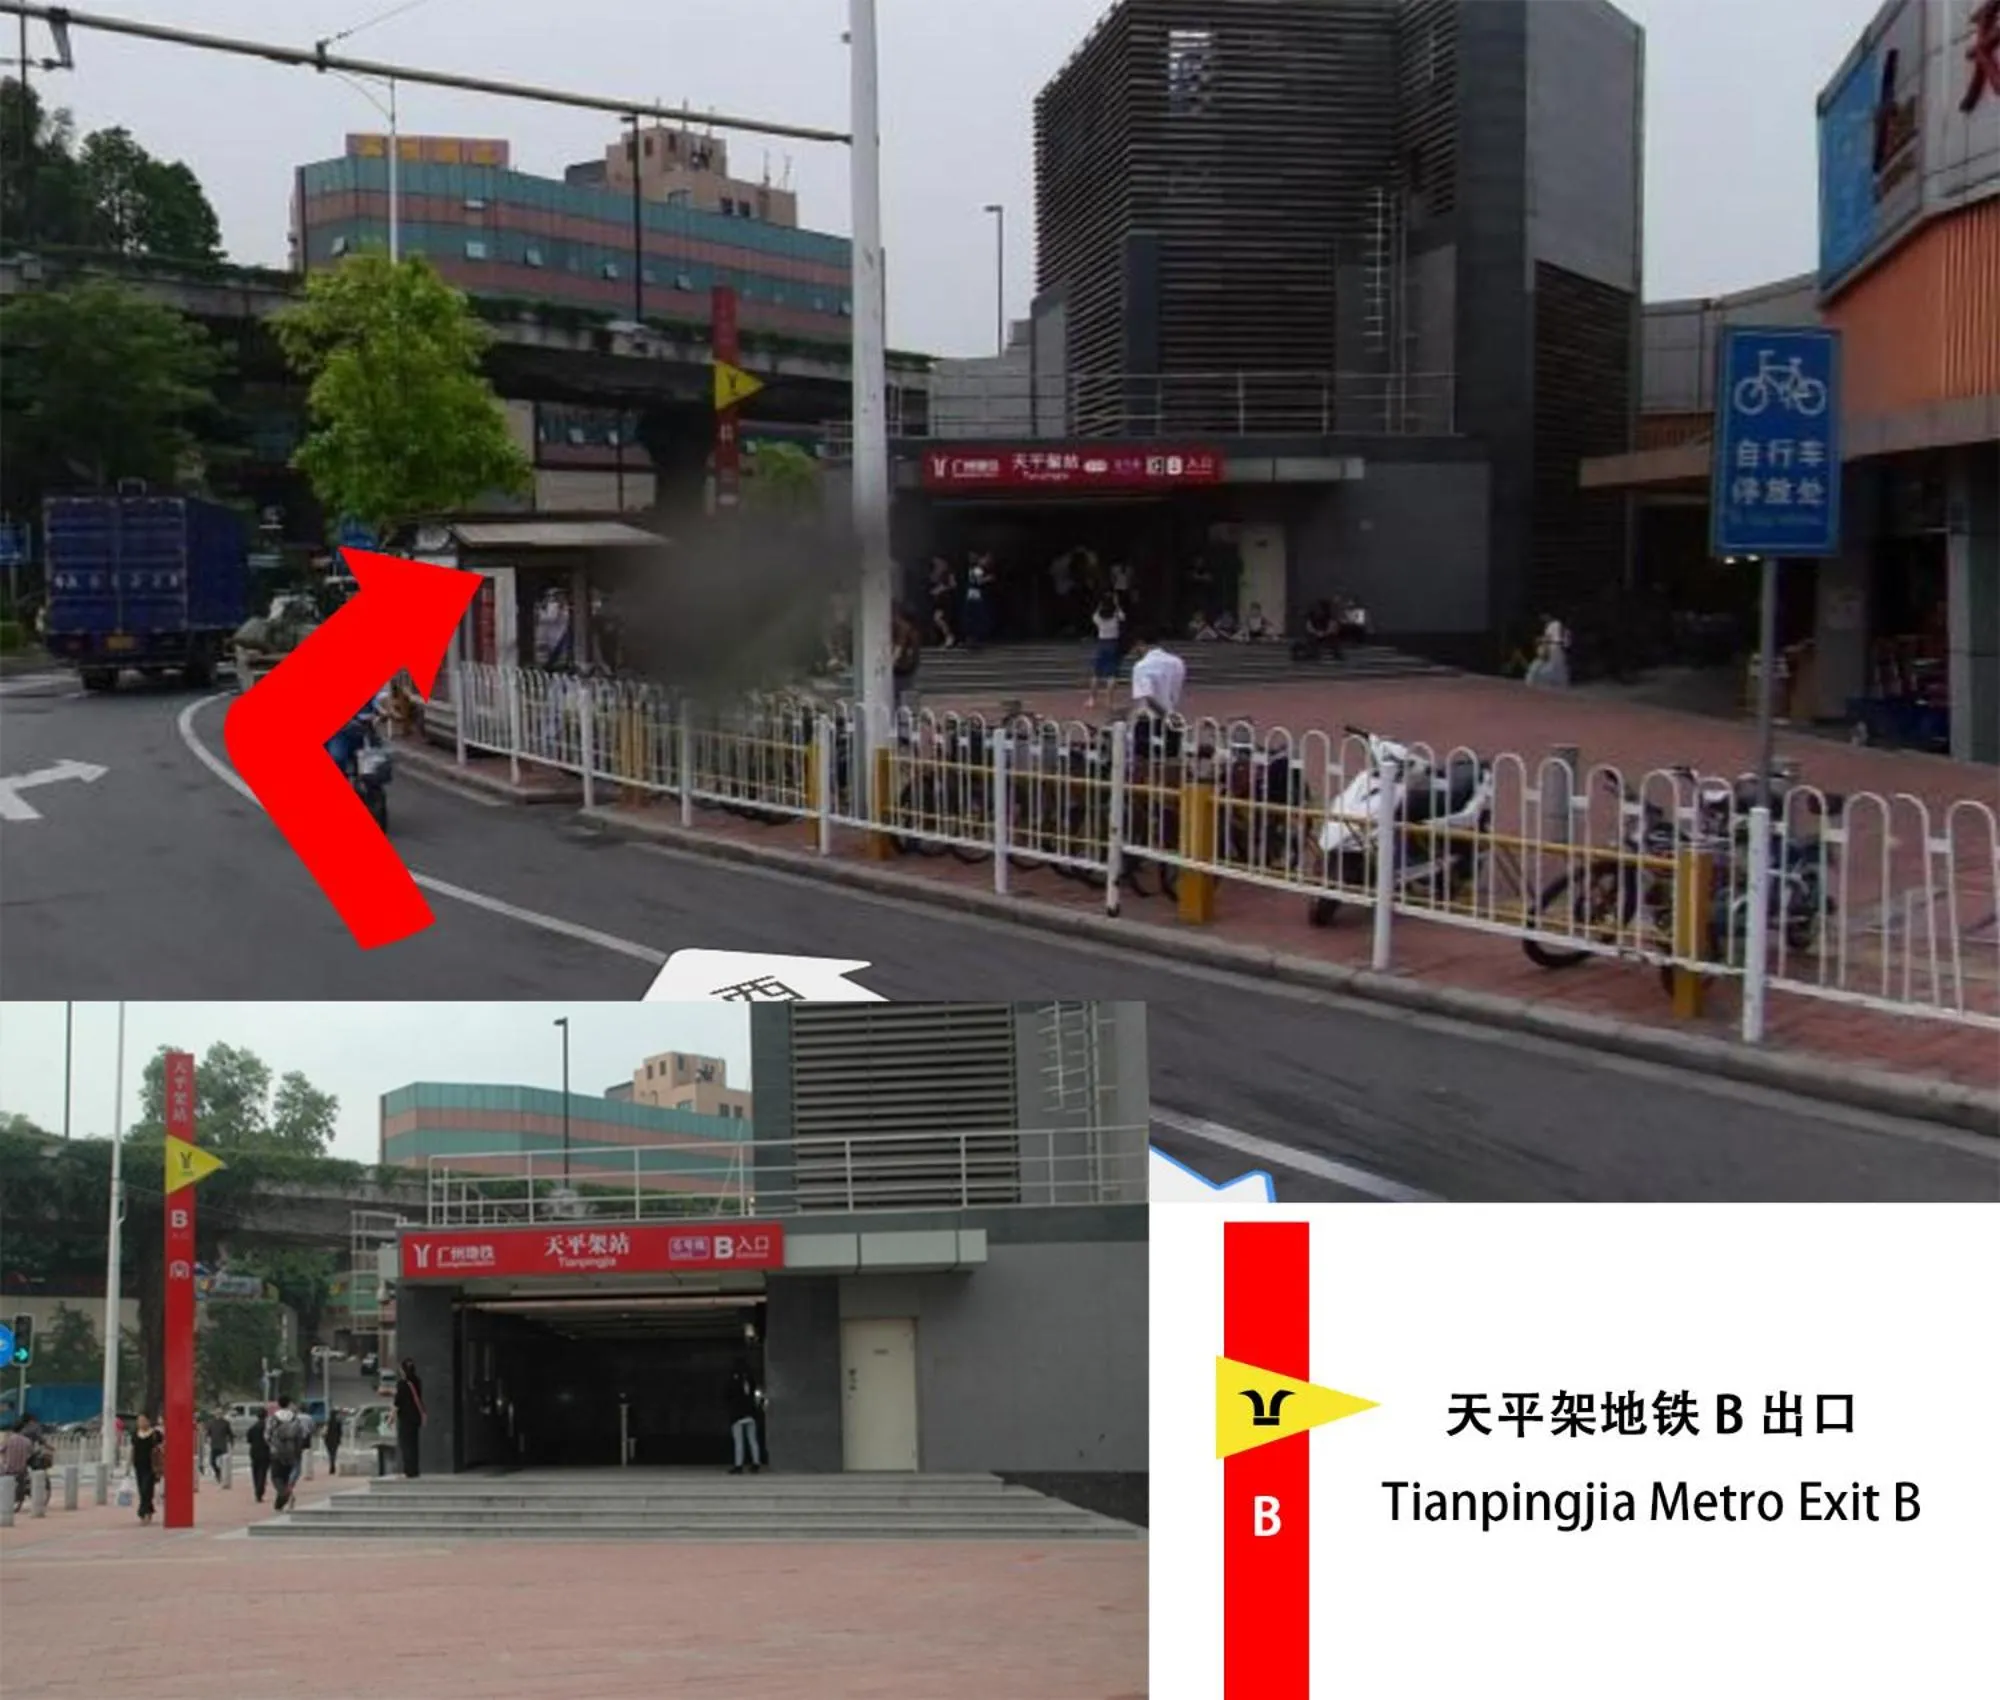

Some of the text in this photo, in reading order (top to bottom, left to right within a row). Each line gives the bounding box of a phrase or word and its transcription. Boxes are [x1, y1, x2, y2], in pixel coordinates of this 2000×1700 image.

[1738, 439, 1825, 468] 自行车
[1732, 476, 1825, 505] 停放处
[171, 1208, 188, 1229] B
[544, 1231, 630, 1256] 天平架站
[714, 1236, 734, 1260] B
[735, 1236, 769, 1251] 入口
